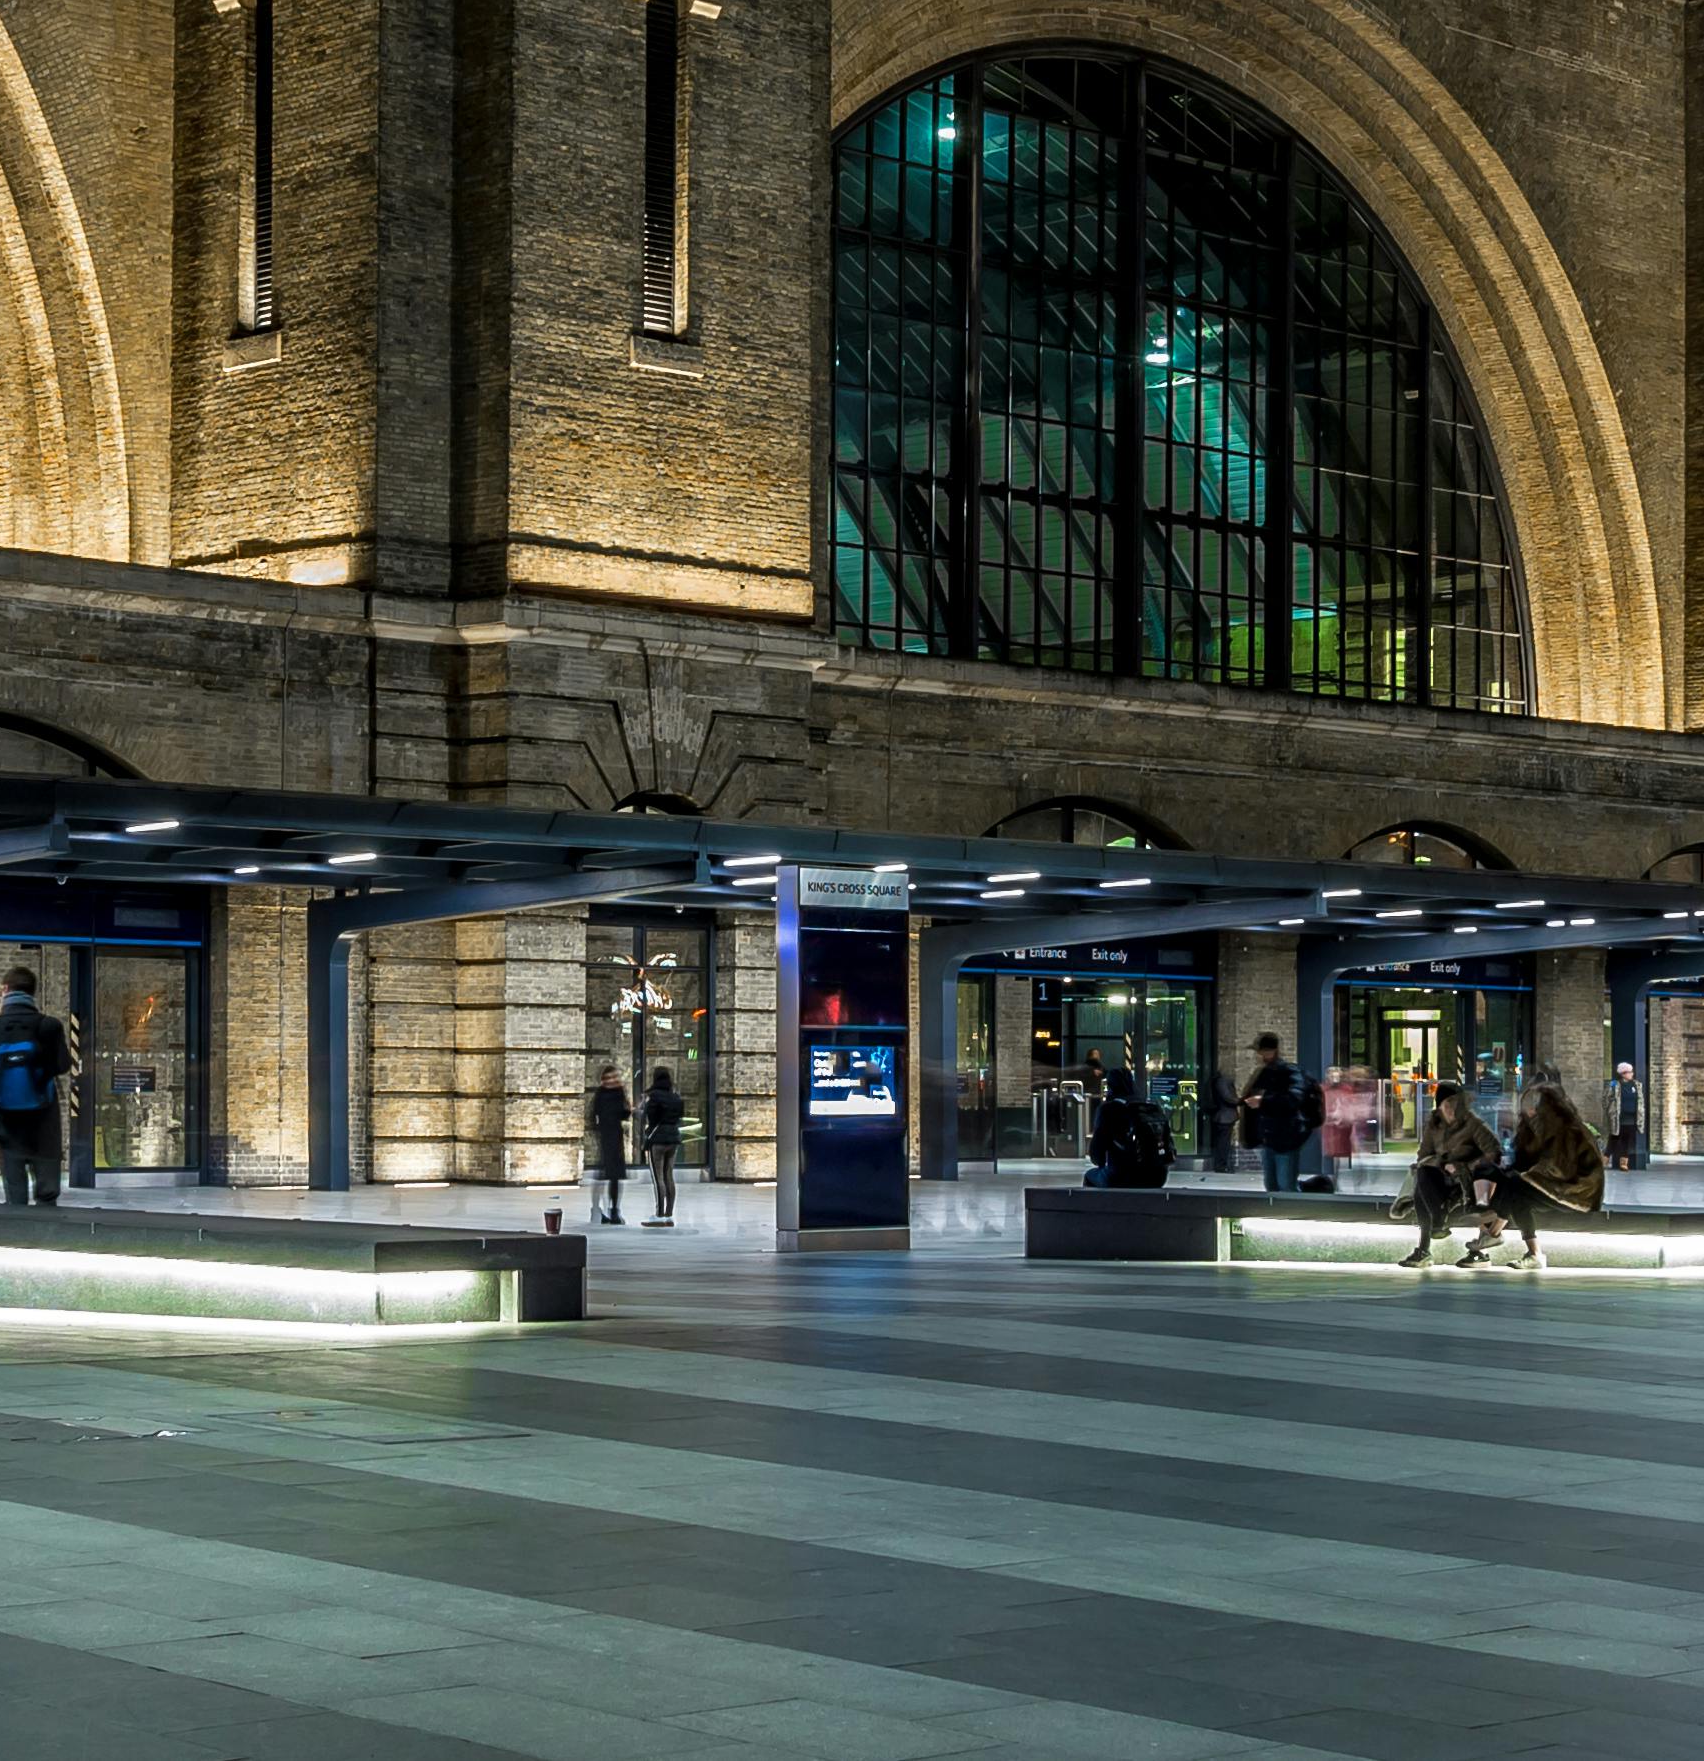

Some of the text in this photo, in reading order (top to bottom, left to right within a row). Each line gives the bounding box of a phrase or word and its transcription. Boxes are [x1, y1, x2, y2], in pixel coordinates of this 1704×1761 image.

[837, 883, 866, 895] CROSS
[867, 884, 902, 897] SQUARE
[1029, 947, 1128, 964] Entrance Exit only
[1038, 982, 1048, 1001] 1
